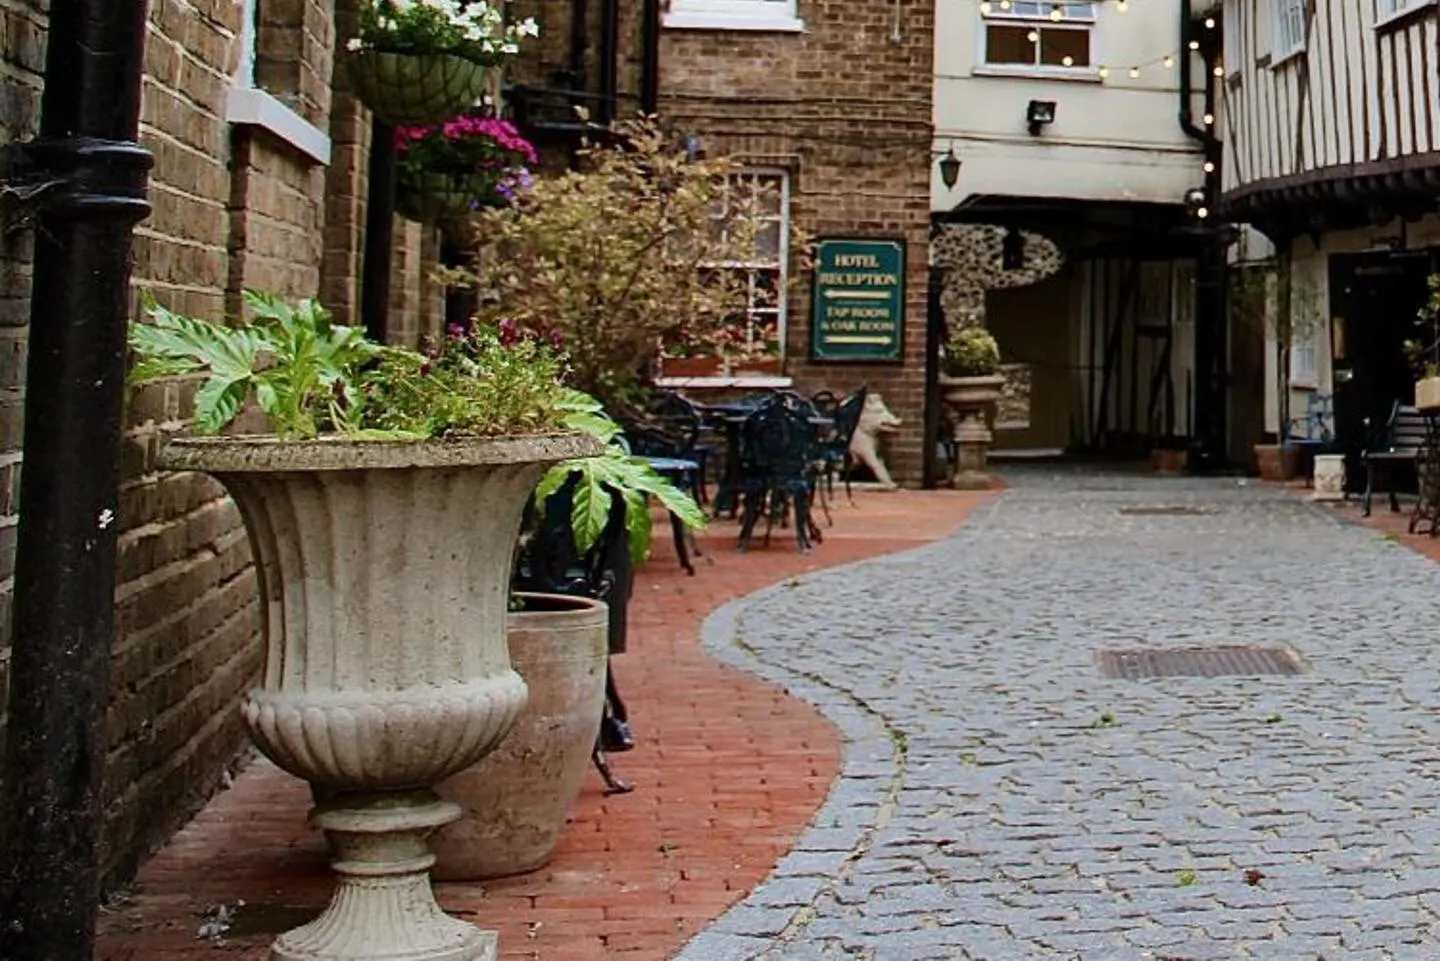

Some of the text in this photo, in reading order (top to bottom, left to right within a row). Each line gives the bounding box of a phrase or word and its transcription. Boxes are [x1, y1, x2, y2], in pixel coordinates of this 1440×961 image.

[834, 253, 880, 268] HOTEL
[819, 272, 898, 286] RECEPTION
[827, 307, 890, 319] TAP ROOM
[831, 321, 856, 332] OAK
[858, 322, 895, 332] ROOM
